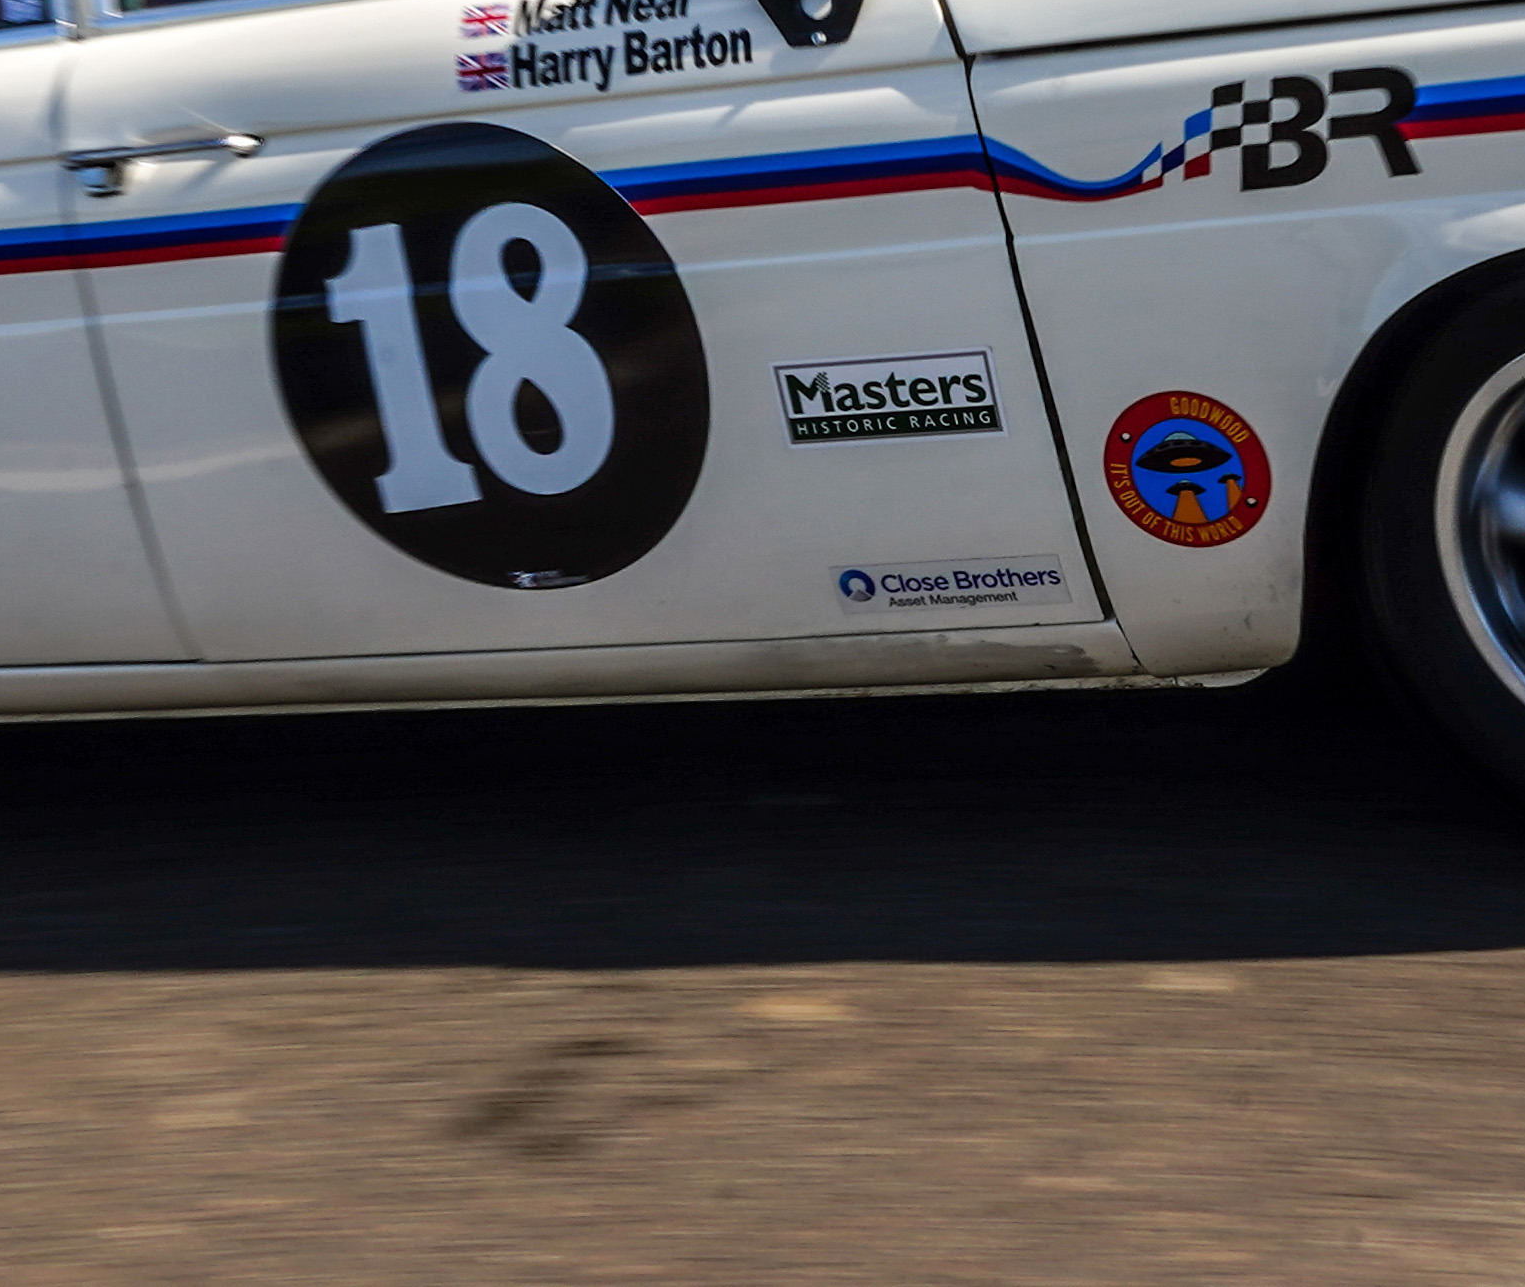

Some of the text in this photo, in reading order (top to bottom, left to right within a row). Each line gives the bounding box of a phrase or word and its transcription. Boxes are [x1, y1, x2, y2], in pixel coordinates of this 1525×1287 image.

[509, 23, 754, 92] Harry Barton
[1238, 66, 1422, 192] BR
[323, 201, 615, 514] 18
[784, 371, 988, 415] Masters
[796, 410, 992, 435] HISTORIC RACING
[1169, 396, 1251, 443] GOODWOOD
[1110, 463, 1245, 543] IT'S OUT OF THIS WORLD
[880, 567, 1061, 594] Close Brothers
[888, 591, 1019, 607] Asset Management
